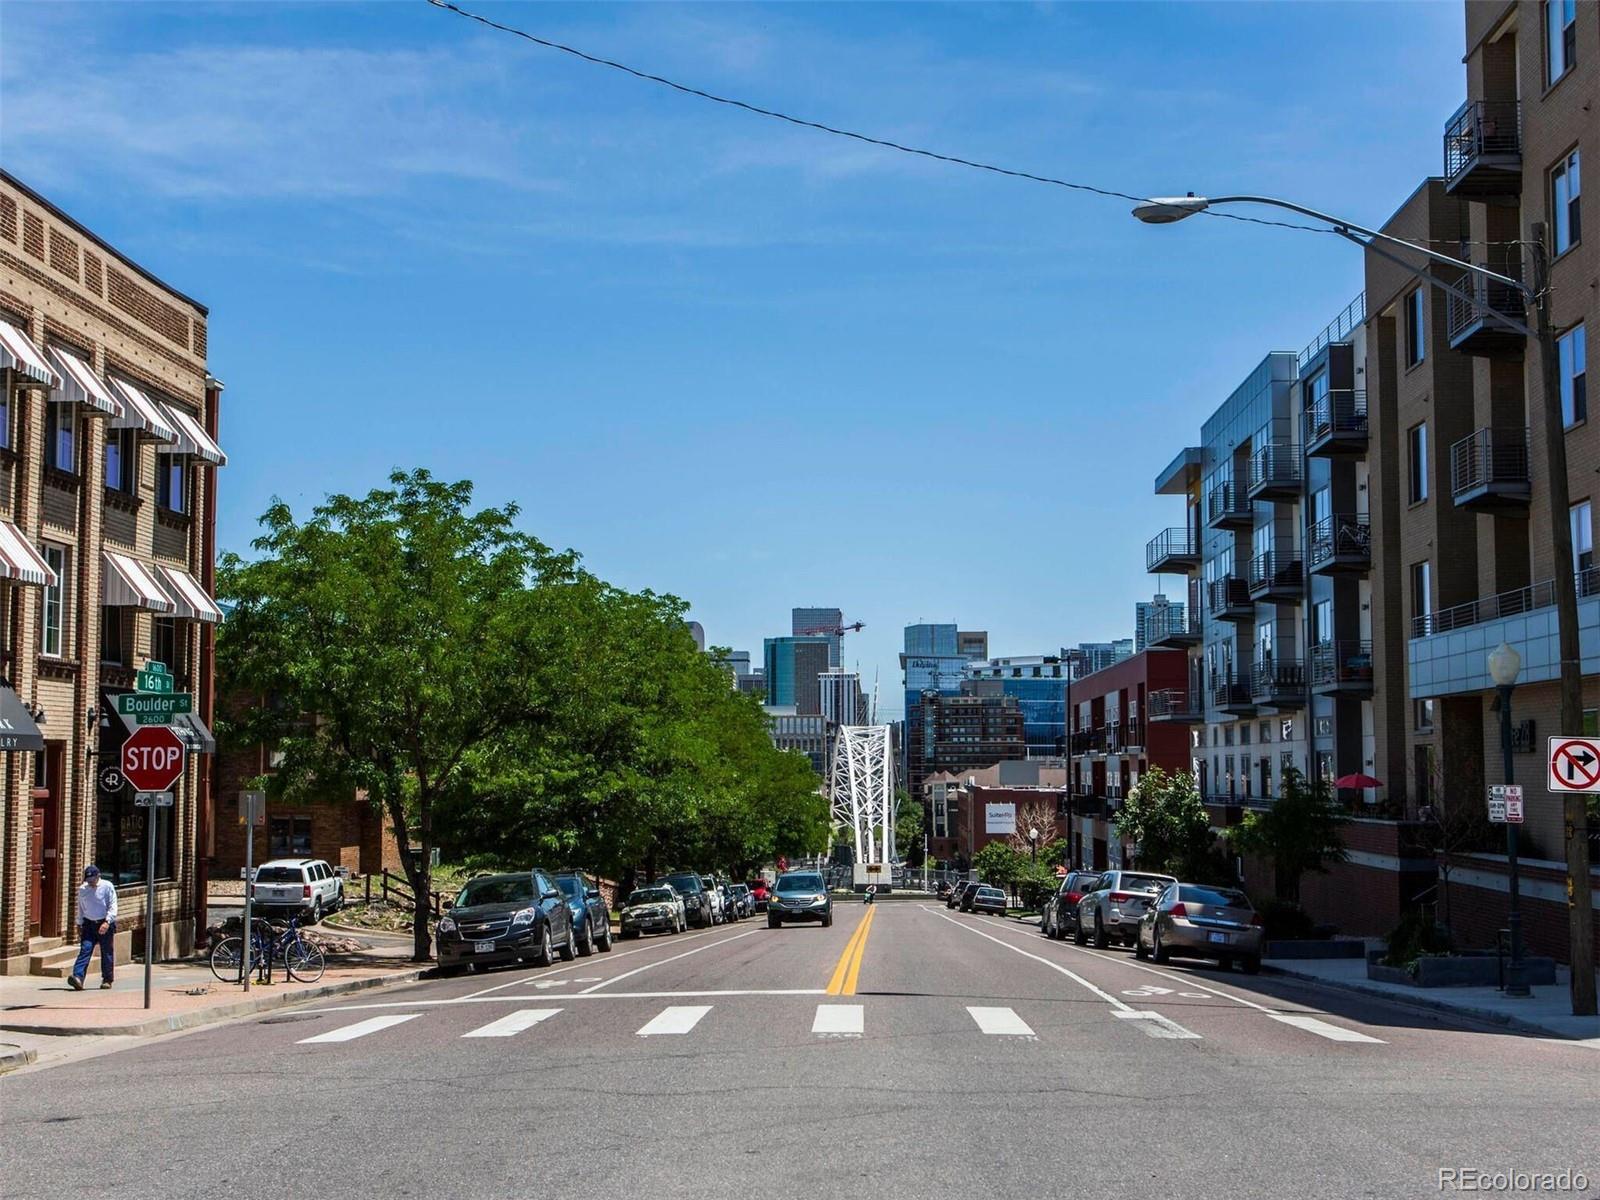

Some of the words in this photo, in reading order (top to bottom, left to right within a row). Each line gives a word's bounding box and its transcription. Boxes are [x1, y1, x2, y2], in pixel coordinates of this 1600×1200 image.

[144, 674, 162, 690] 16th
[126, 697, 175, 712] Boulder
[180, 699, 188, 708] St
[142, 715, 165, 723] 2600
[126, 747, 180, 770] STOP
